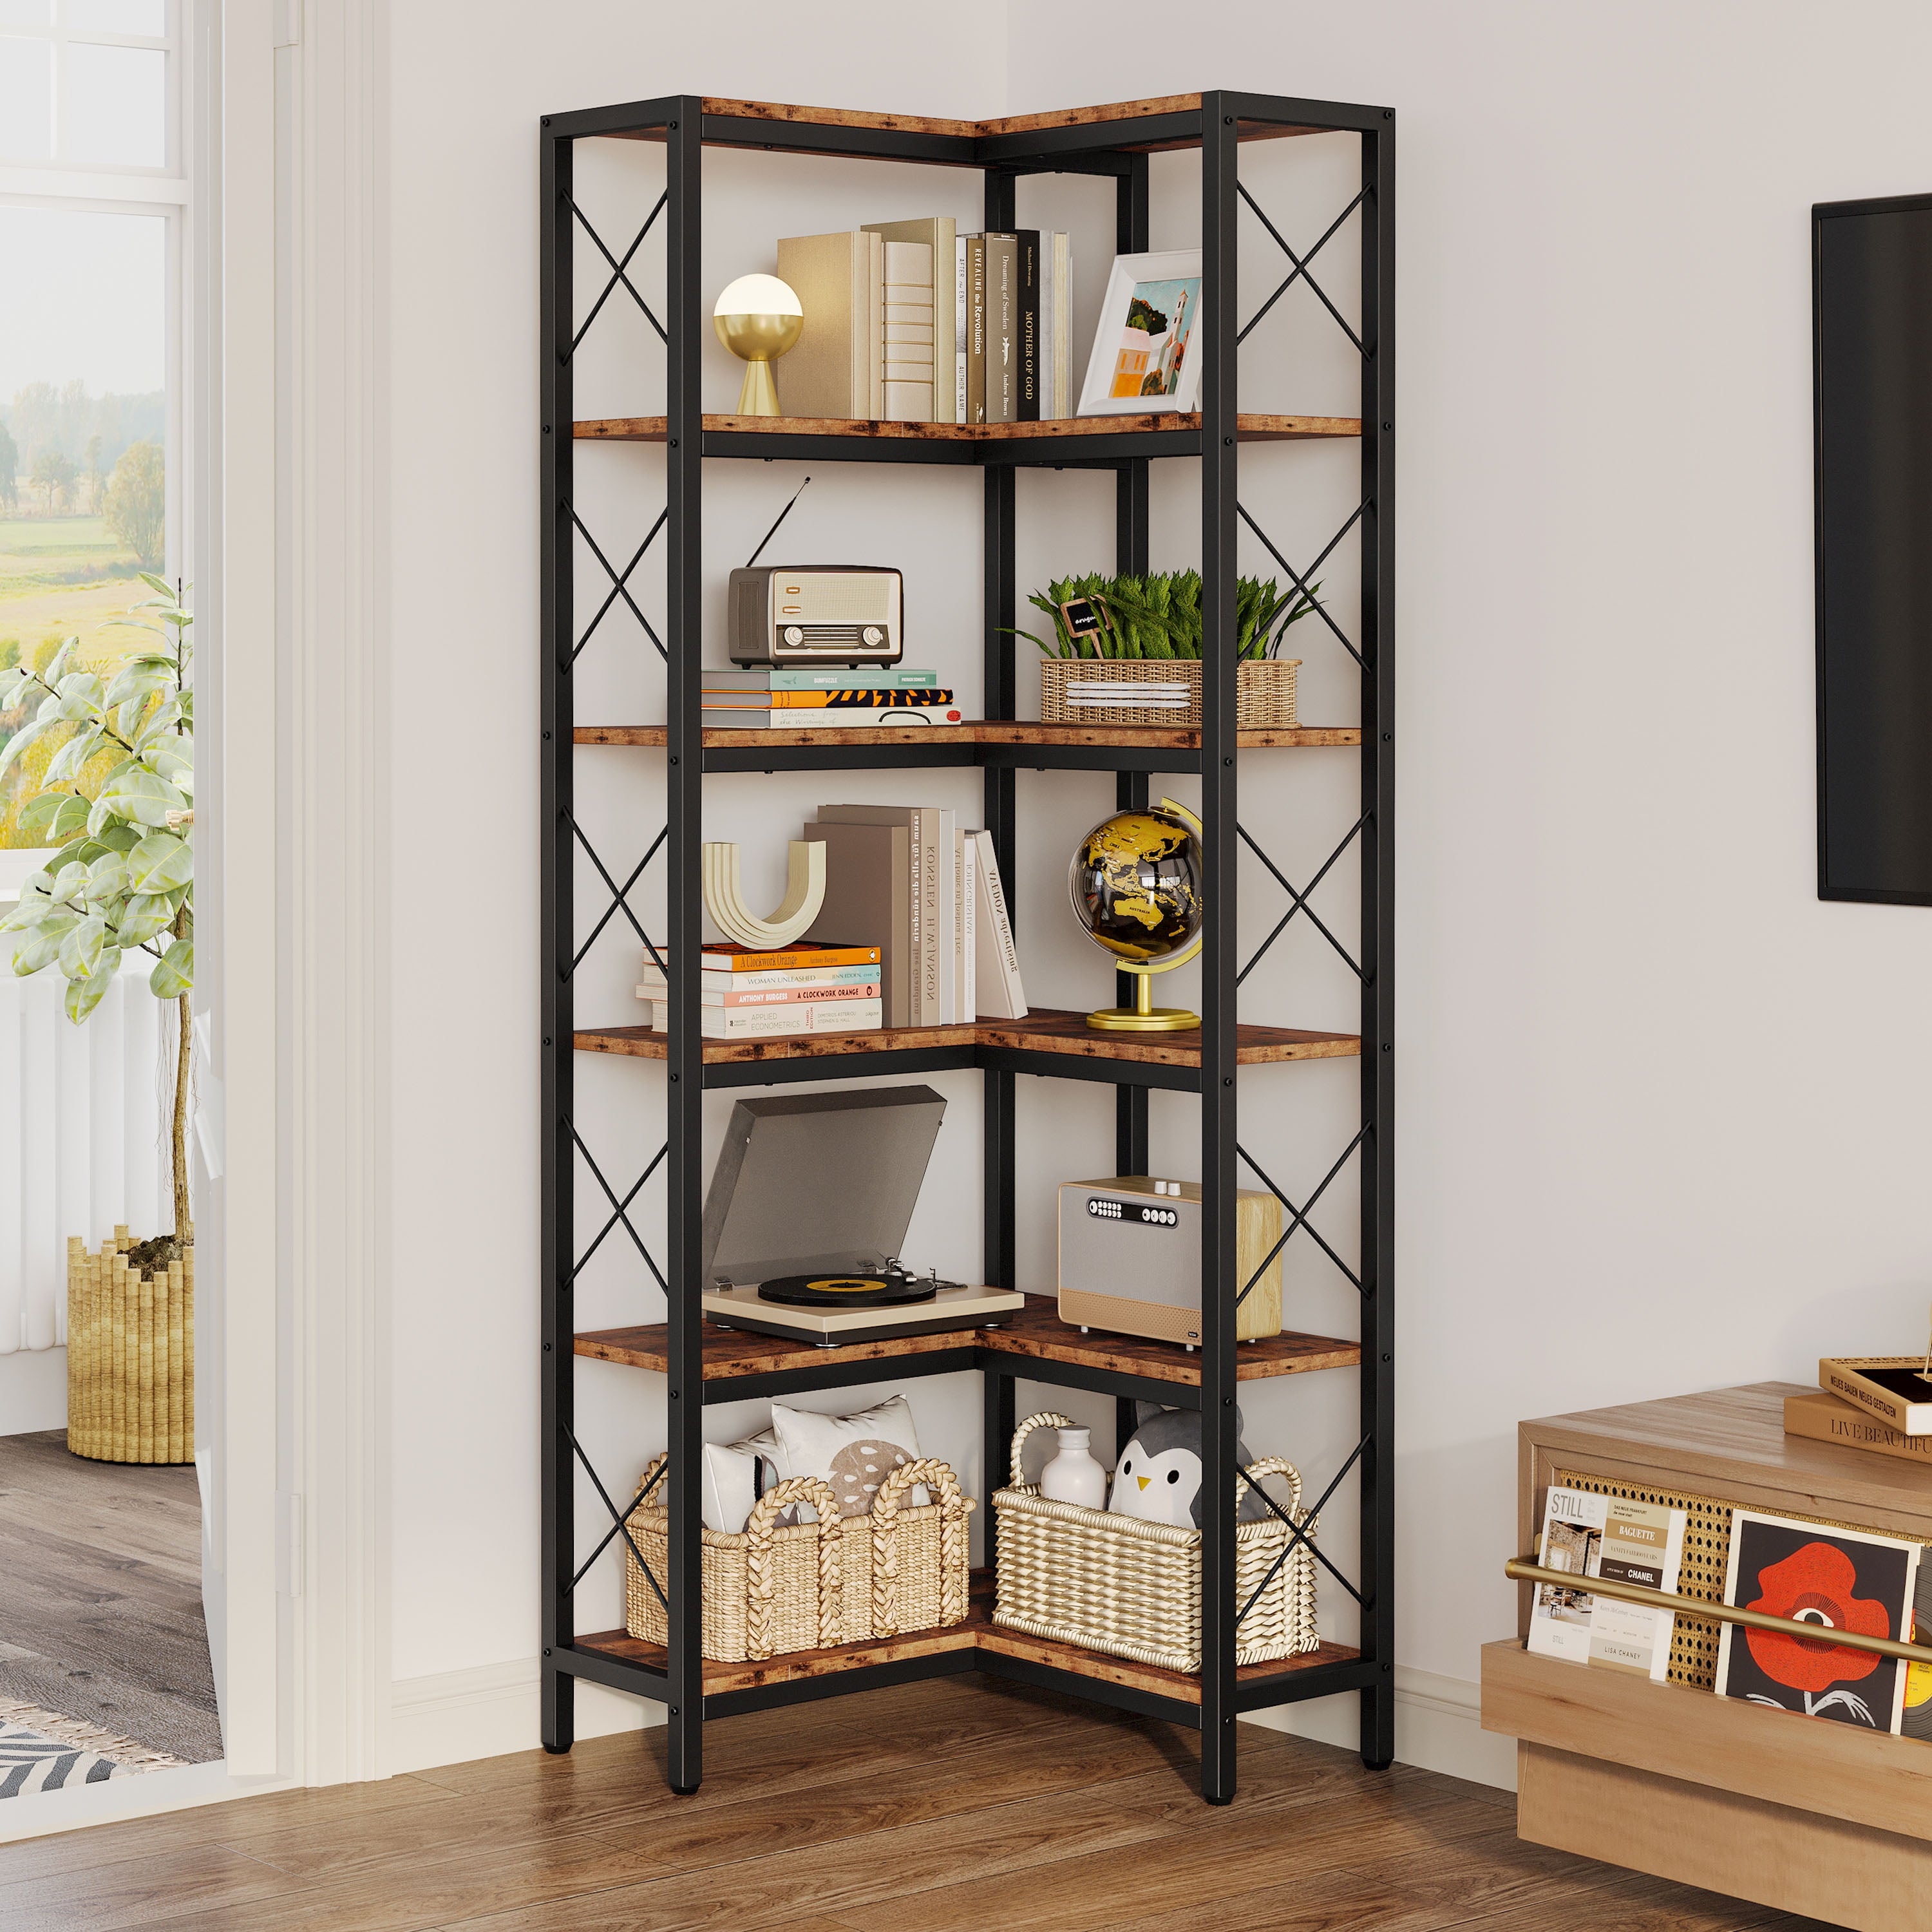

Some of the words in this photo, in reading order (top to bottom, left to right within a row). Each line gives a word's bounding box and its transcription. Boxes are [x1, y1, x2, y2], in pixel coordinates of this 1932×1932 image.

[1001, 256, 1009, 291] Dreaming
[1003, 292, 1009, 301] of
[974, 306, 983, 354] Revolution
[1025, 312, 1034, 357] MOTHER
[1025, 359, 1034, 374] OF
[1025, 376, 1034, 400] GOD
[741, 957, 745, 967] A
[747, 954, 776, 967] Clockwork
[777, 954, 798, 967] Orange
[739, 994, 764, 1003] ANTHONY
[803, 990, 837, 998] CLOCKWORK
[751, 1021, 800, 1030] ECONOMETRICS
[1830, 1375, 1844, 1390] NEUES
[1844, 1382, 1858, 1397] BAUEN
[1859, 1390, 1873, 1405] NEUES
[1873, 1398, 1897, 1419] GESTALTEN
[1830, 1419, 1861, 1439] LIVE
[1551, 1493, 1583, 1519] STILL
[1619, 1525, 1655, 1541] BAGUETTE
[1627, 1569, 1654, 1582] CHANEL
[1552, 1634, 1564, 1645] STILL
[1604, 1646, 1617, 1654] LISA
[1618, 1649, 1642, 1660] CHANEY
